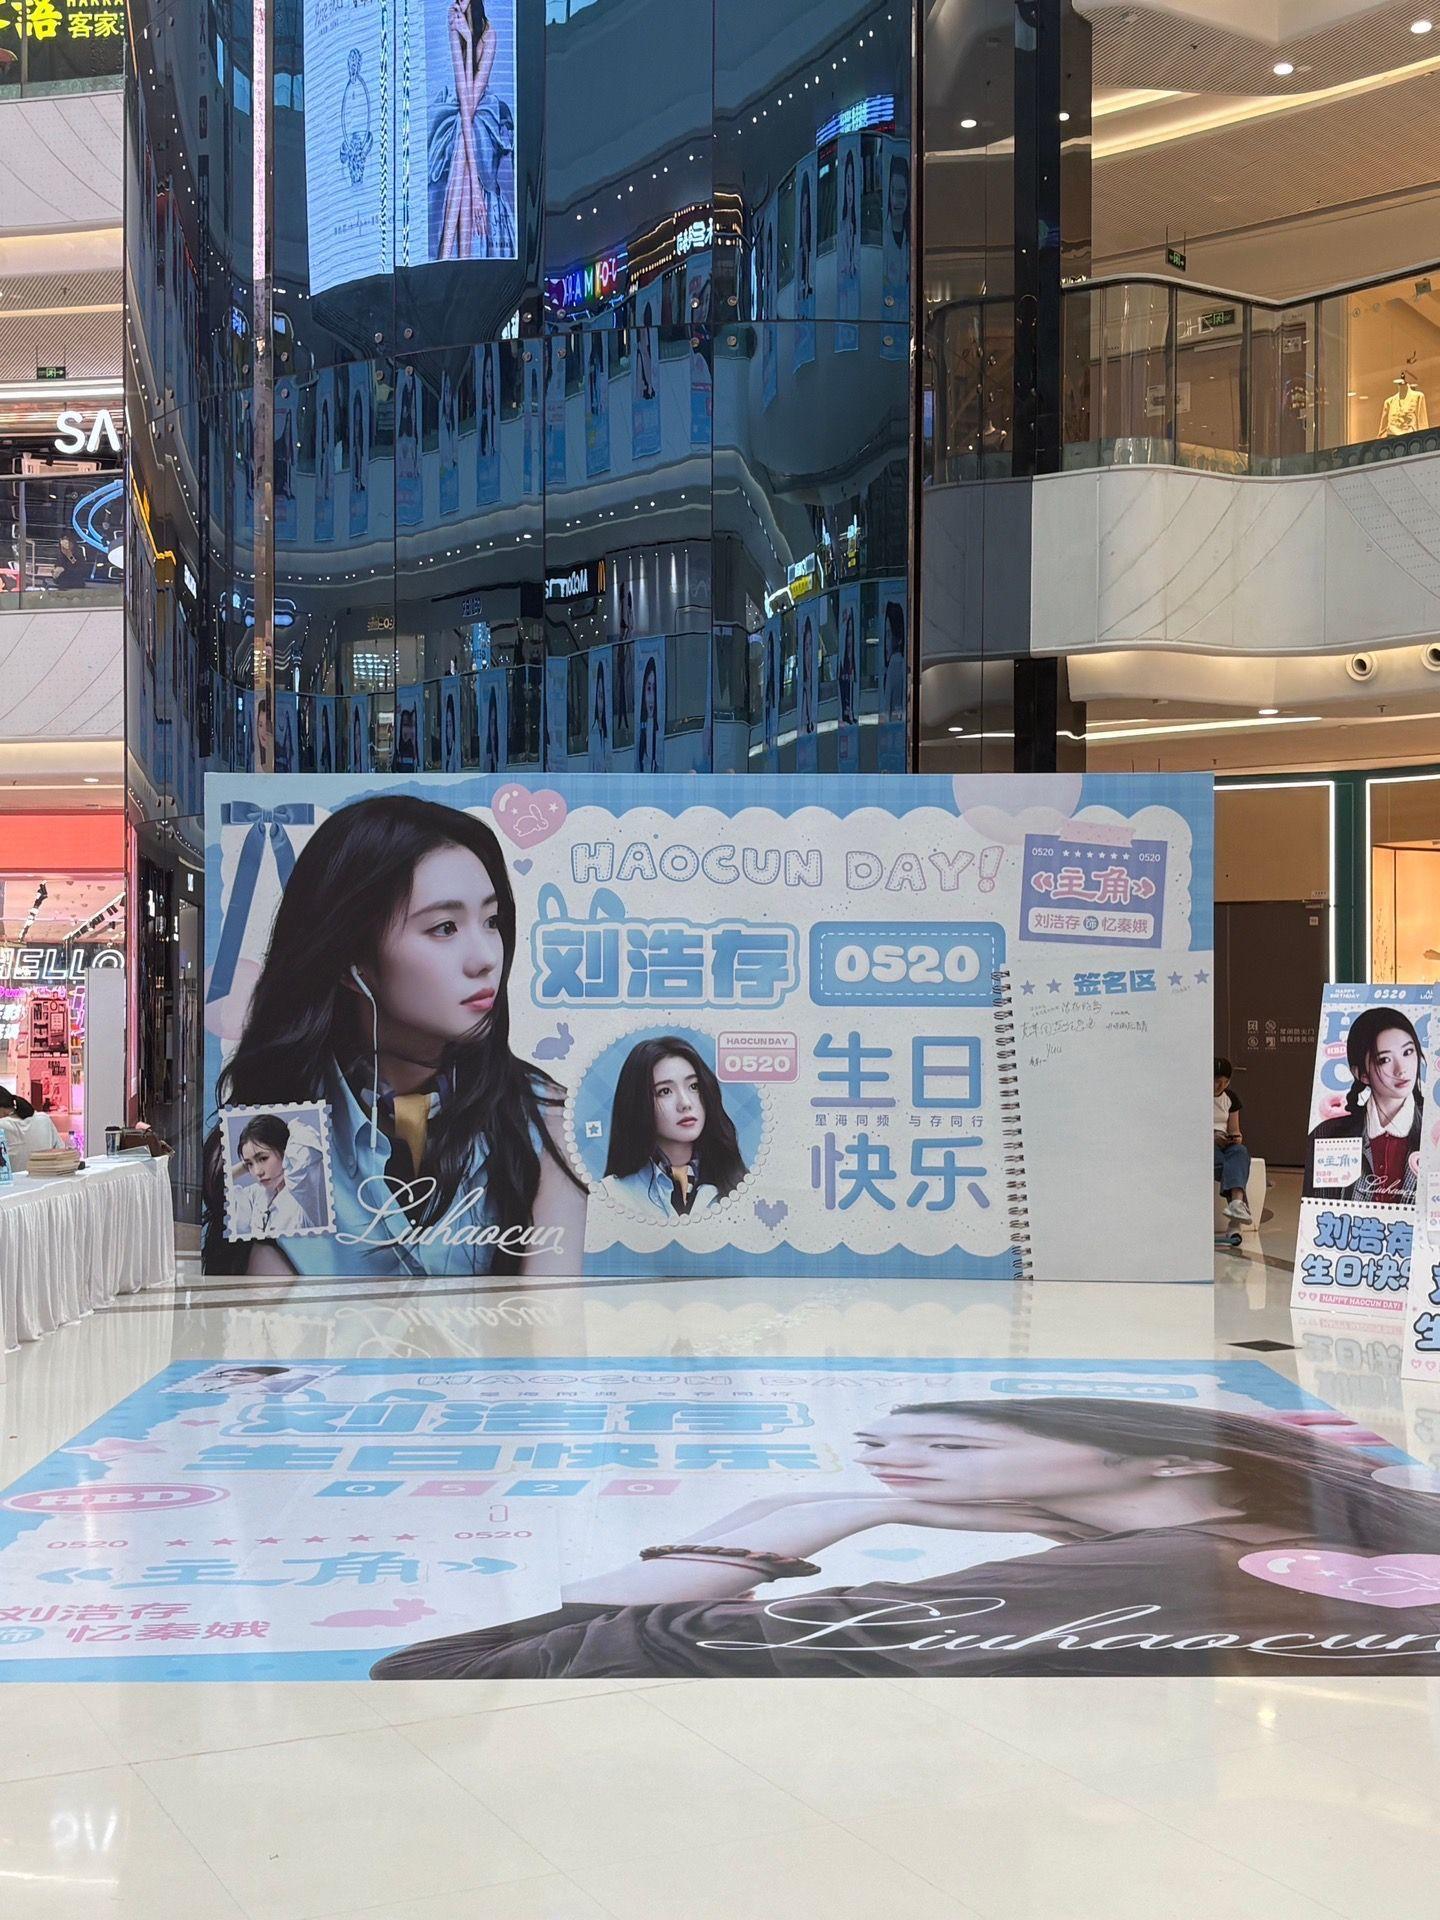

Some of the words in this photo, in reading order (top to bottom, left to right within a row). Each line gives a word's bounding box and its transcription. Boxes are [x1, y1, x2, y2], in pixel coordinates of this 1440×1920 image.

[67, 11, 125, 38] 客家
[1031, 847, 1054, 857] 0520
[1139, 853, 1161, 863] 0520
[571, 841, 822, 887] HAOCUN
[846, 845, 1004, 893] DAY!
[1034, 913, 1080, 930] 刘浩存
[1102, 916, 1148, 934] 忆秦娥
[541, 928, 789, 999] 刘浩存
[834, 944, 981, 984] 0520
[1073, 969, 1157, 997] 签名区
[1374, 989, 1406, 1000] 0520
[724, 1055, 791, 1073] 0520
[810, 1031, 982, 1108] 生日
[815, 1114, 890, 1128] 星海同频
[909, 1114, 984, 1128] 与存同行
[811, 1132, 990, 1212] 快乐
[335, 1175, 565, 1257] Liuhaocun
[1322, 1295, 1348, 1304] HAPPY
[417, 1375, 732, 1386] HAOCUN
[759, 1376, 952, 1387] DAY!
[241, 1402, 794, 1432] 刘浩存
[182, 1442, 821, 1471] 生日快乐
[34, 1490, 192, 1506] HBD
[47, 1540, 129, 1549] 0520
[453, 1530, 533, 1540] 0520
[0, 1602, 192, 1622] 刘浩存
[66, 1620, 271, 1643] 忆秦娥
